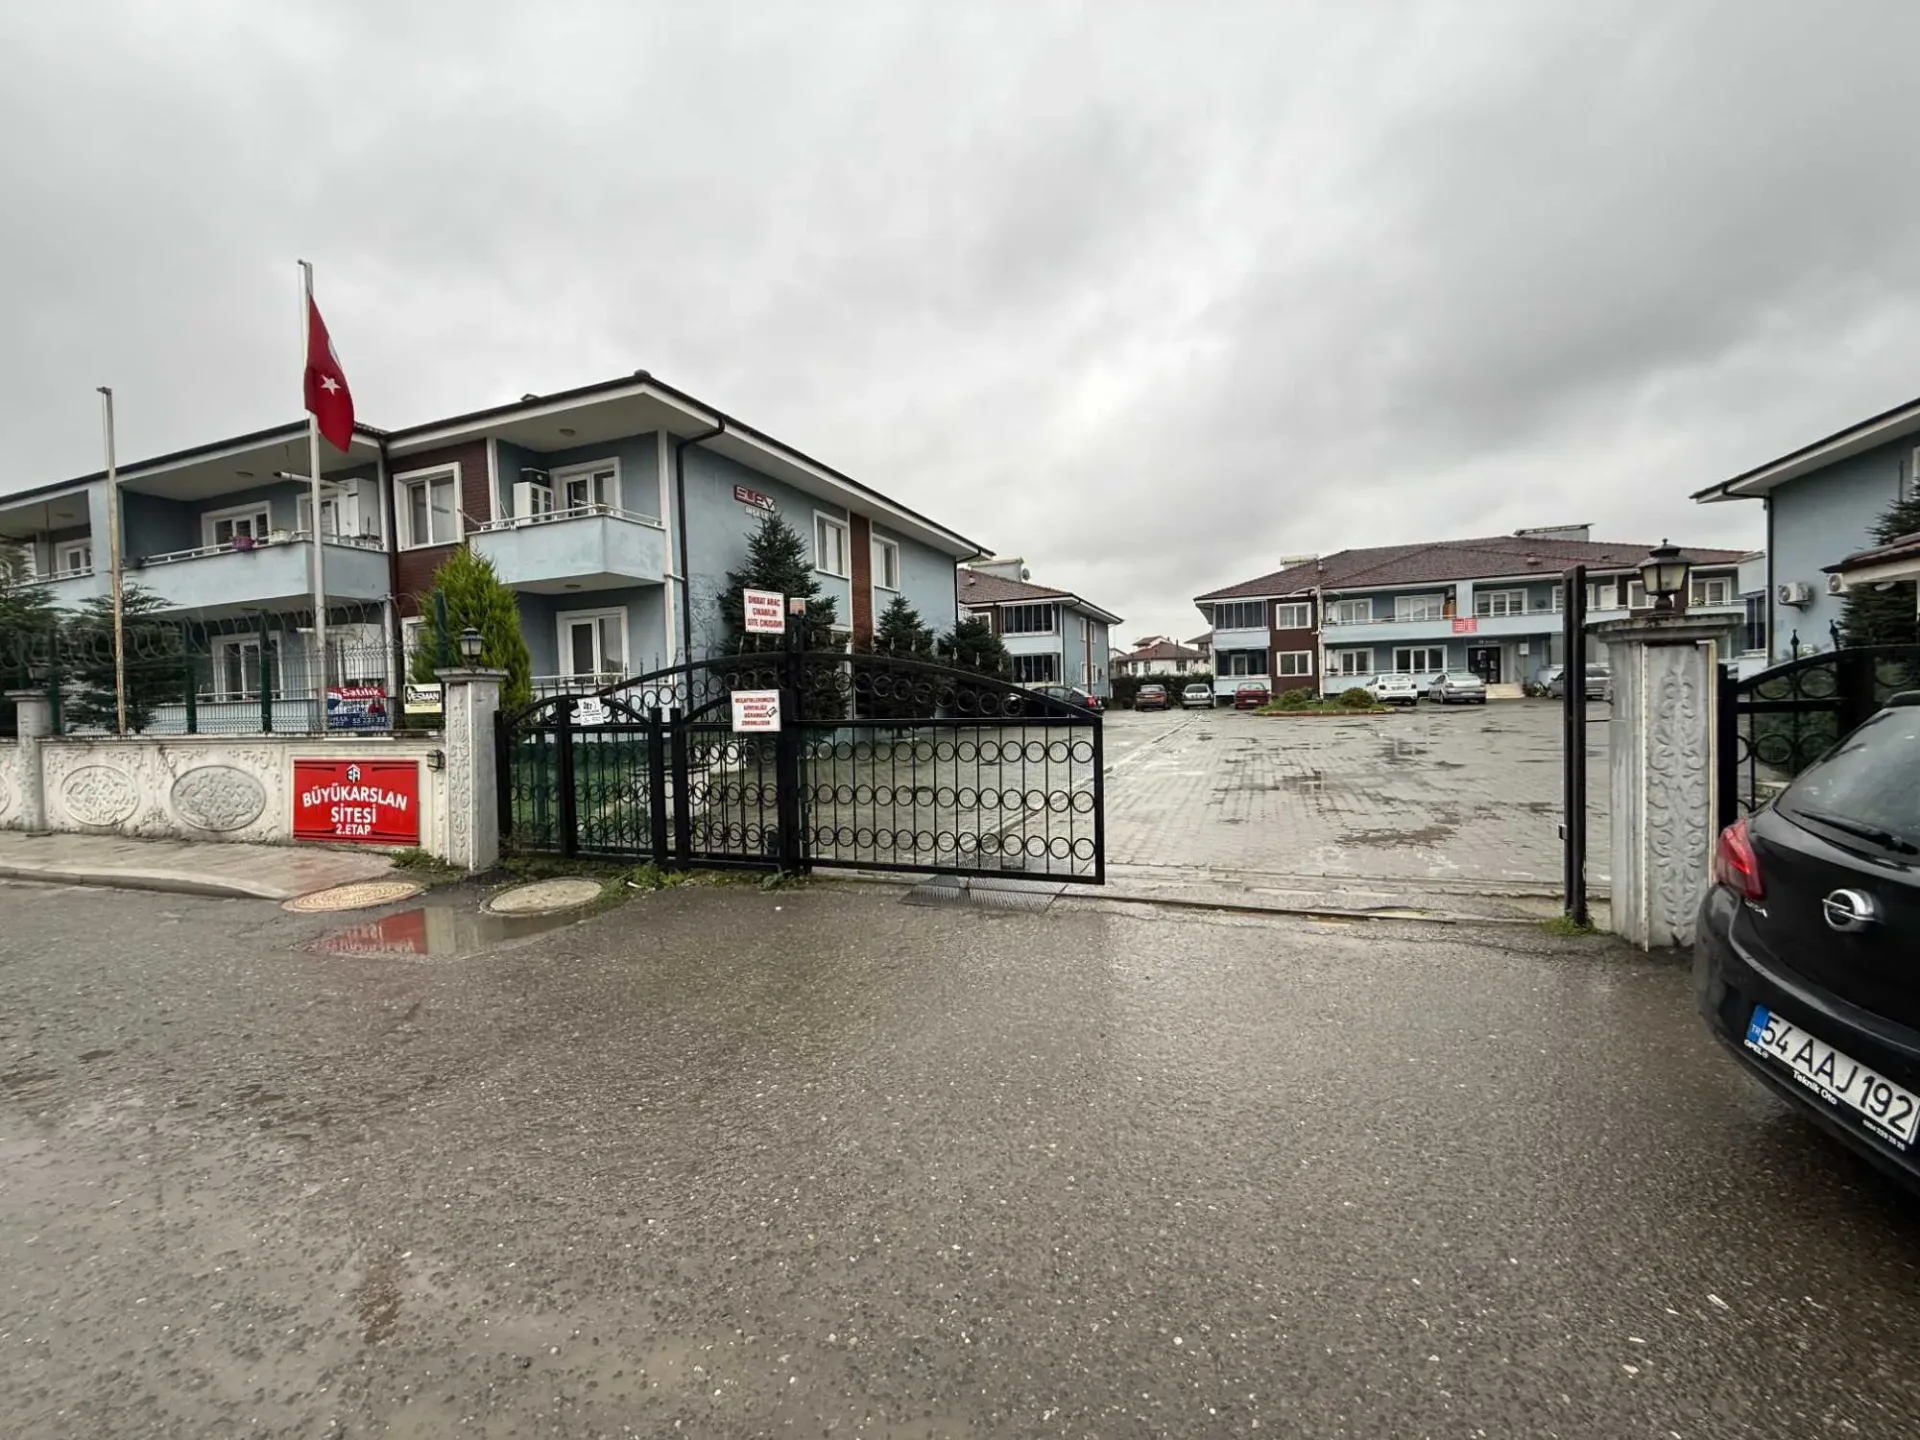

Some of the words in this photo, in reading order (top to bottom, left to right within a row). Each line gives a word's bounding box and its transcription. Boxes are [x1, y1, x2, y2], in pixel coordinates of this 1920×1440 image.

[302, 783, 407, 811] BÜYÜKARSLAN
[331, 802, 376, 823] SİTESİ
[336, 823, 371, 835] 2.ETAP
[1761, 1017, 1793, 1055] 54
[1791, 1038, 1859, 1094] AAJ
[1860, 1075, 1914, 1134] 192
[1793, 1069, 1820, 1095] Teknik
[1820, 1089, 1838, 1105] Oto
